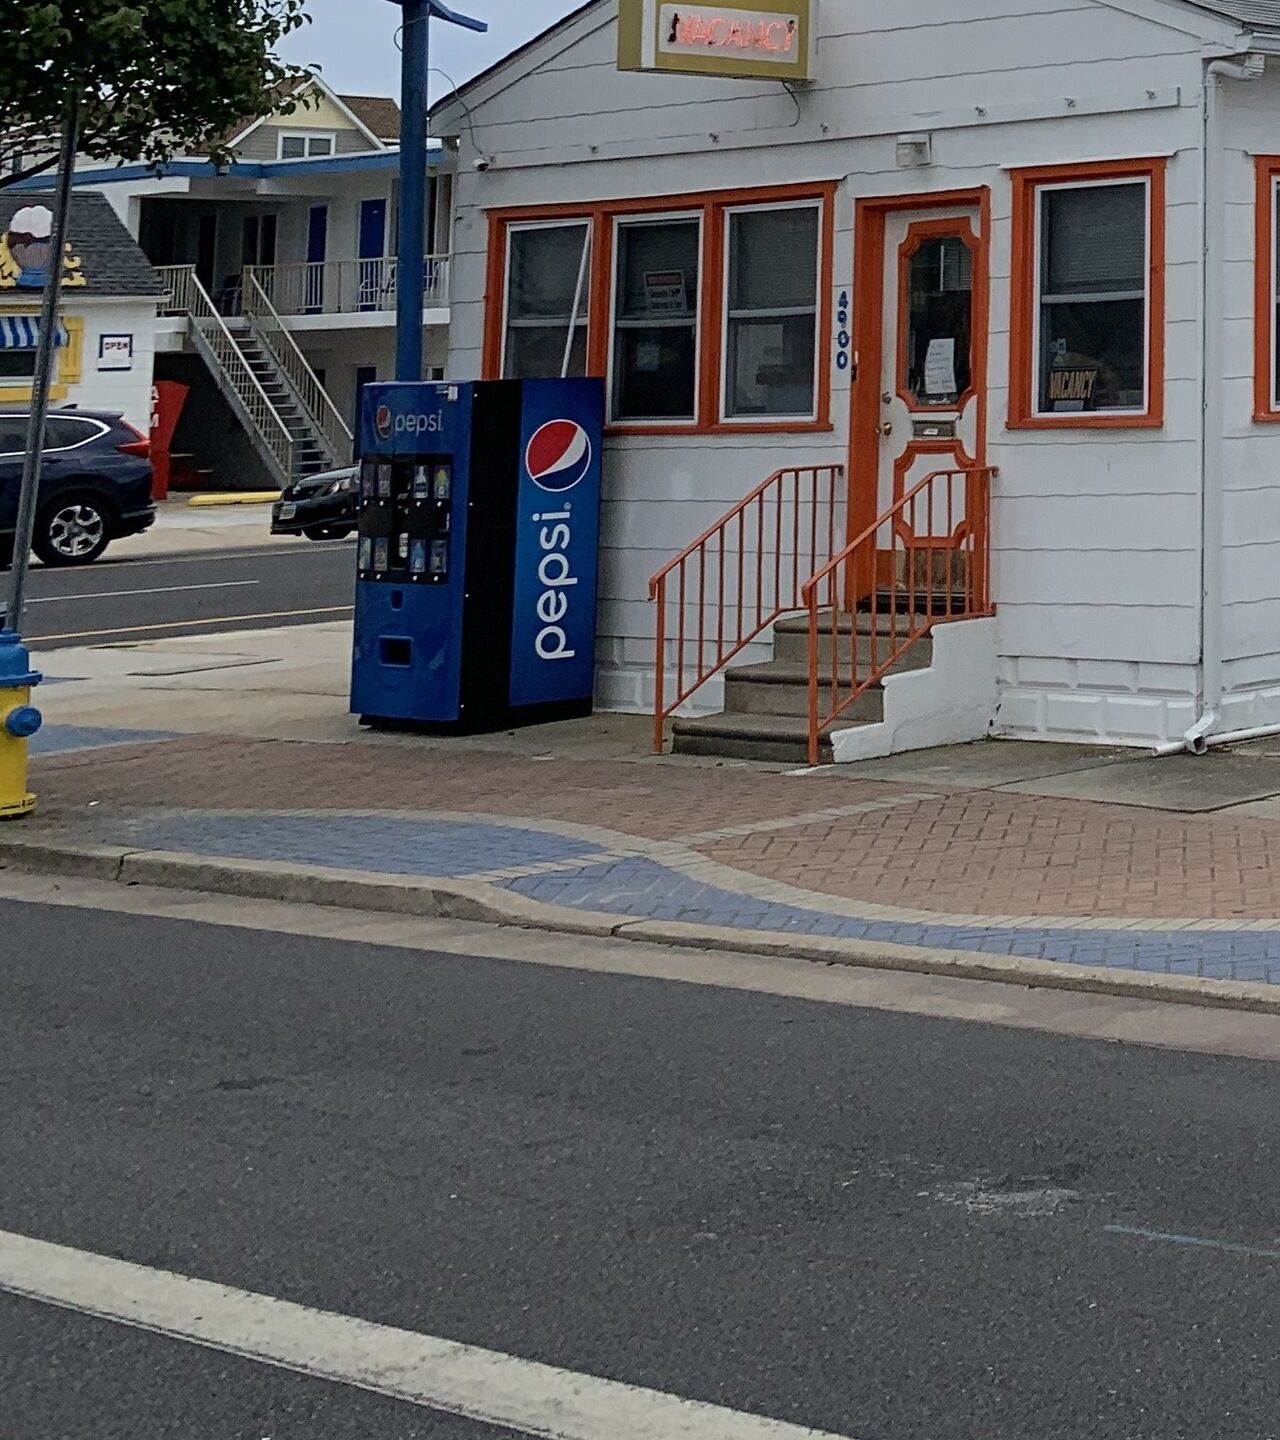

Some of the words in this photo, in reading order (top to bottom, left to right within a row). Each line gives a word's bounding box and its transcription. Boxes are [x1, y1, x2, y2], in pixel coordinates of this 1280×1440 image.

[677, 13, 799, 53] VACANCY
[105, 342, 128, 350] OPEN
[836, 291, 850, 370] 4900
[1050, 370, 1097, 399] VACANCY
[394, 409, 443, 438] pepsi
[532, 510, 578, 660] pepsi
